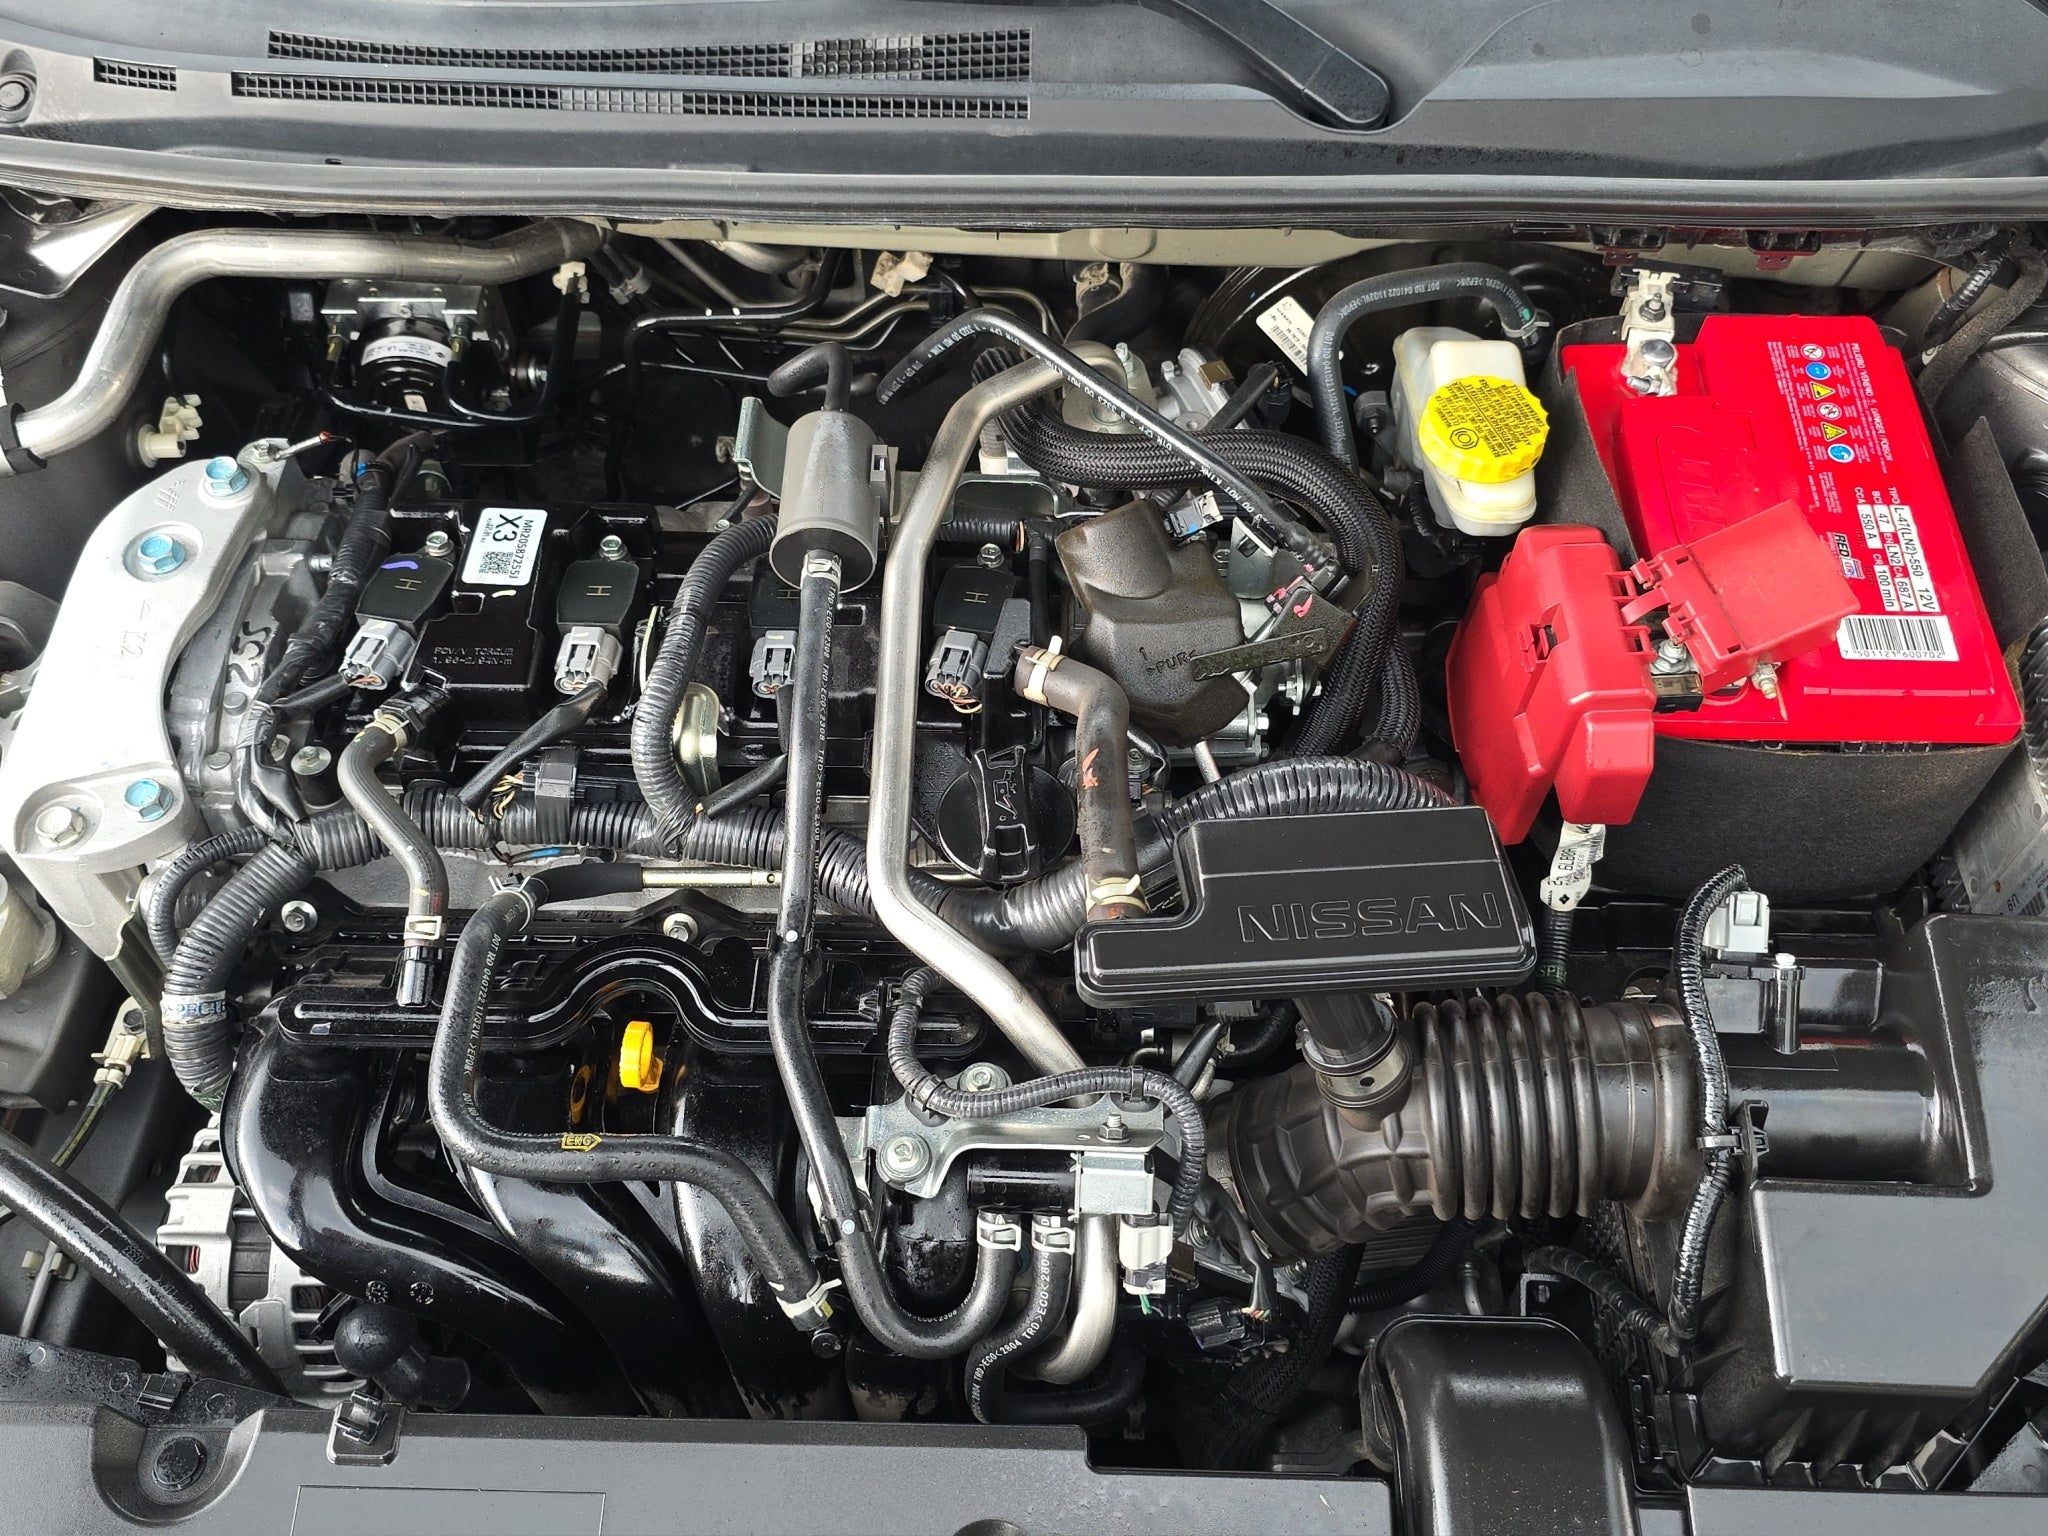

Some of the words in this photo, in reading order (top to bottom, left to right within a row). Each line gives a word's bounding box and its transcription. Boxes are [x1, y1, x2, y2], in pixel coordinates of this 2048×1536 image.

[1200, 467, 1222, 485] KINK
[1224, 486, 1242, 501] NOT
[1854, 487, 1866, 503] CCA
[1861, 514, 1875, 530] 550
[1878, 513, 1890, 524] 47
[493, 513, 523, 542] X3
[1867, 532, 1877, 540] A
[1834, 534, 1850, 558] RED
[1886, 545, 1901, 564] LN2
[1888, 487, 1900, 504] TIPO
[1918, 588, 1936, 610] 12V
[1873, 553, 1883, 565] CR
[1877, 569, 1891, 586] 100
[1897, 581, 1911, 598] 687
[1882, 589, 1895, 608] min
[1903, 601, 1914, 609] A
[474, 647, 514, 656] TORQUE
[1238, 893, 1501, 942] NISSAN
[492, 933, 501, 951] DOT
[478, 968, 492, 1004] 040722
[470, 1005, 484, 1041] 11/32VL
[567, 1136, 592, 1147] ENG
[1022, 1252, 1050, 1340] TRD>ECO<2804
